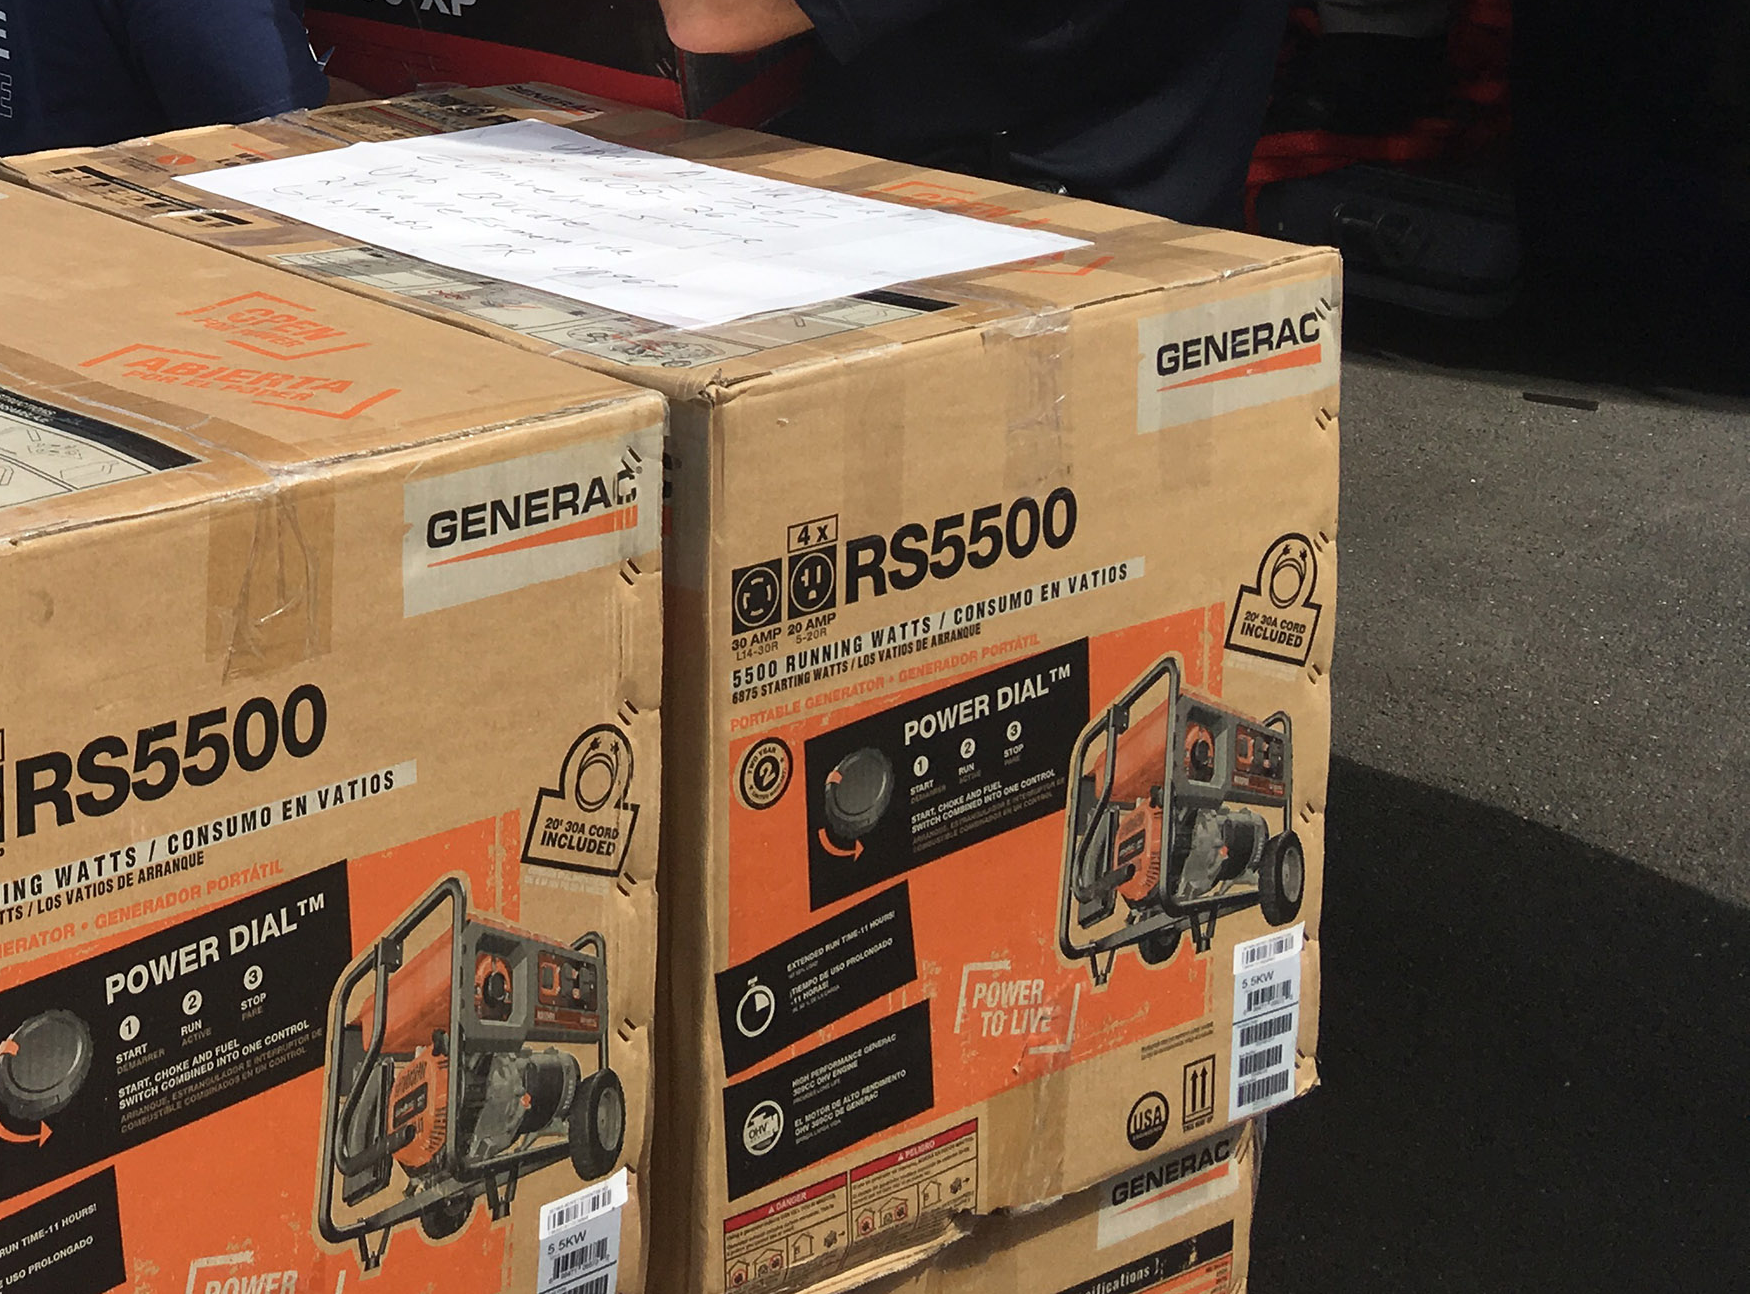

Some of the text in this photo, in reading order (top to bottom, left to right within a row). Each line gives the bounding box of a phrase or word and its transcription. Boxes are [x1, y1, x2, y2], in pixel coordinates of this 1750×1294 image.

[227, 307, 347, 341] OPEN
[1155, 314, 1320, 378] GENERAC
[123, 355, 355, 395] ABIERTA
[226, 380, 318, 401] PODER
[426, 470, 637, 548] GENERAC
[797, 530, 810, 547] 4
[845, 487, 1077, 605] RS5500
[732, 628, 782, 651] 30 AMP
[733, 563, 1128, 689] 5500 RUNNING WATTS CONSUMO EN VATIOS
[787, 613, 837, 637] 20 AMP
[1240, 622, 1303, 648] INCLUDED
[1260, 614, 1277, 627] 30A
[1279, 619, 1306, 634] CORD
[904, 692, 989, 746] POWER
[15, 683, 328, 838] RS5500
[1003, 744, 1024, 759] STOP
[958, 763, 975, 776] RUN
[910, 779, 934, 796] START
[54, 846, 137, 889] WATTS
[167, 805, 272, 856] CONSUMO
[282, 795, 308, 822] EN
[318, 769, 395, 811] VATIOS
[540, 831, 616, 858] INCLUDED
[565, 821, 587, 837] 30A
[590, 824, 620, 841] CORD
[37, 894, 62, 915] LOS
[66, 875, 114, 907] VATIOS
[117, 871, 134, 889] DE
[137, 851, 205, 885] ARRANQUE
[95, 885, 202, 930] GENERADOR
[206, 859, 284, 898] PORTÁTIL
[105, 934, 220, 1005] POWER
[240, 993, 267, 1011] STOP
[973, 979, 1044, 1008] POWER
[180, 1020, 202, 1037] RUN
[981, 1010, 1007, 1037] TO
[115, 1043, 148, 1065] START
[119, 1020, 309, 1110] SWITCH COMBINED INTO ONE CONTROL
[155, 1059, 190, 1083] CHOKE
[192, 1050, 213, 1068] AND
[215, 1039, 240, 1059] FUEL
[1132, 1106, 1163, 1131] USA
[1111, 1139, 1230, 1205] GENERAC
[0, 1241, 19, 1259] RUN
[61, 1203, 97, 1228] HOURS!
[6, 1270, 26, 1285] USO
[28, 1236, 93, 1274] PROLONGADO
